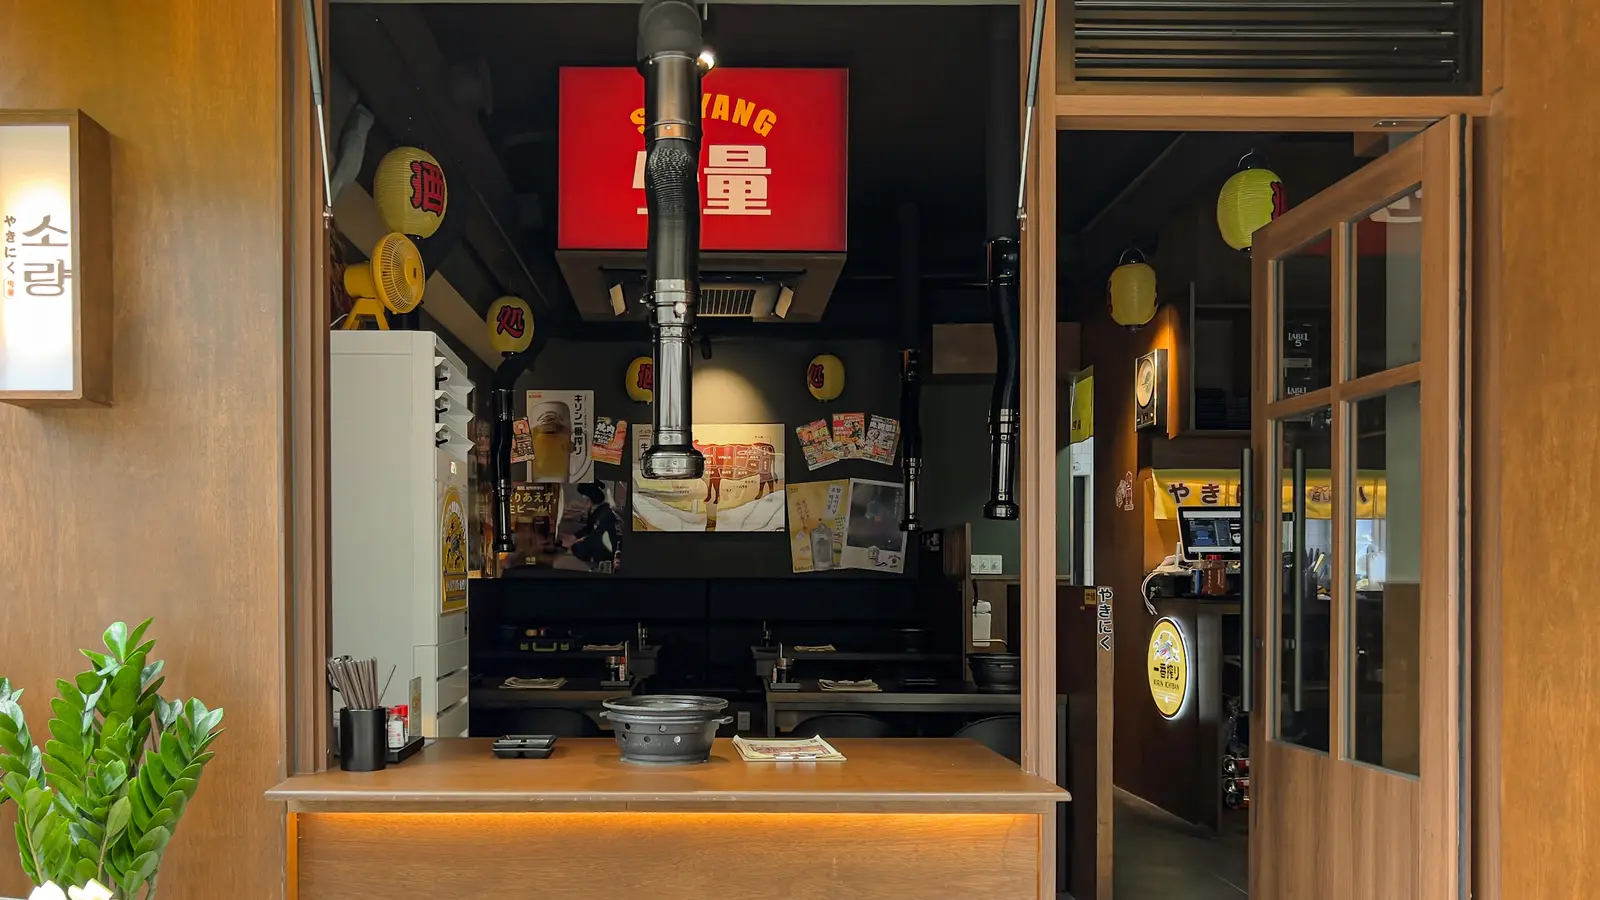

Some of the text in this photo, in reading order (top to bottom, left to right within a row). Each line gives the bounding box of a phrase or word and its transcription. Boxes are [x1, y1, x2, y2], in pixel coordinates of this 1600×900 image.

[630, 93, 777, 138] SYANG
[409, 160, 445, 217] 酒
[633, 144, 771, 216] 量
[4, 215, 17, 274] やきにく
[21, 214, 72, 296] 소랑
[1288, 332, 1310, 342] LABEL
[1294, 339, 1302, 347] 5
[574, 394, 583, 455] キリン一番搾り
[1098, 586, 1114, 652] やきにく
